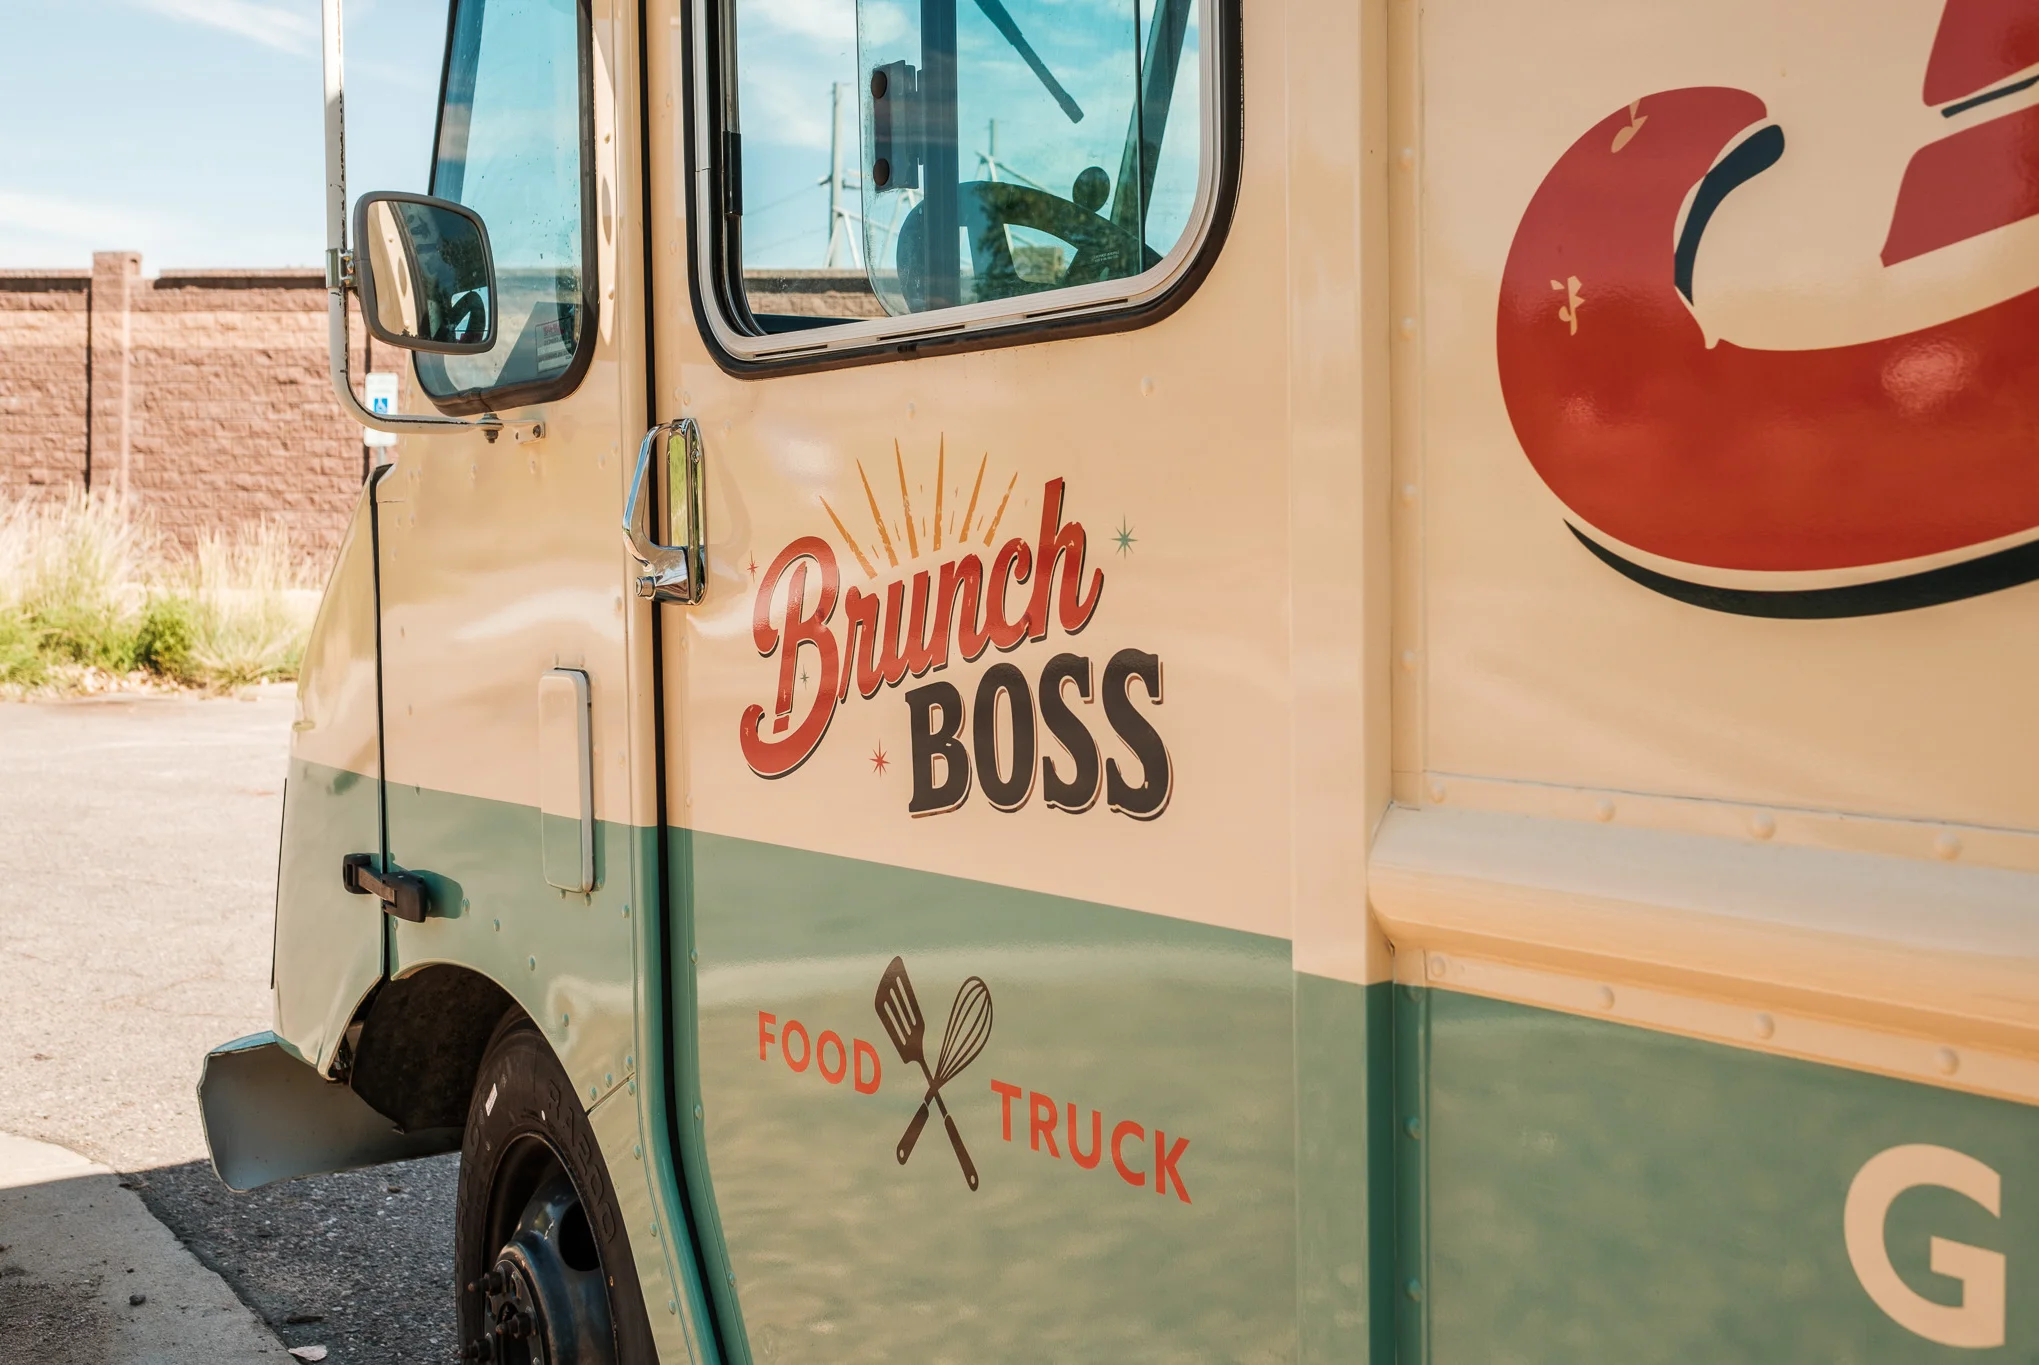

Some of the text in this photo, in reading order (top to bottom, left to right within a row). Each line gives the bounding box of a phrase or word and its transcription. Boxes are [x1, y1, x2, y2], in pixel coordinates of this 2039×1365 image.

[740, 476, 1103, 780] Brunch
[905, 648, 1173, 821] BOSS
[758, 1010, 1192, 1205] FOOD TRUCK
[1843, 1143, 2006, 1349] G
